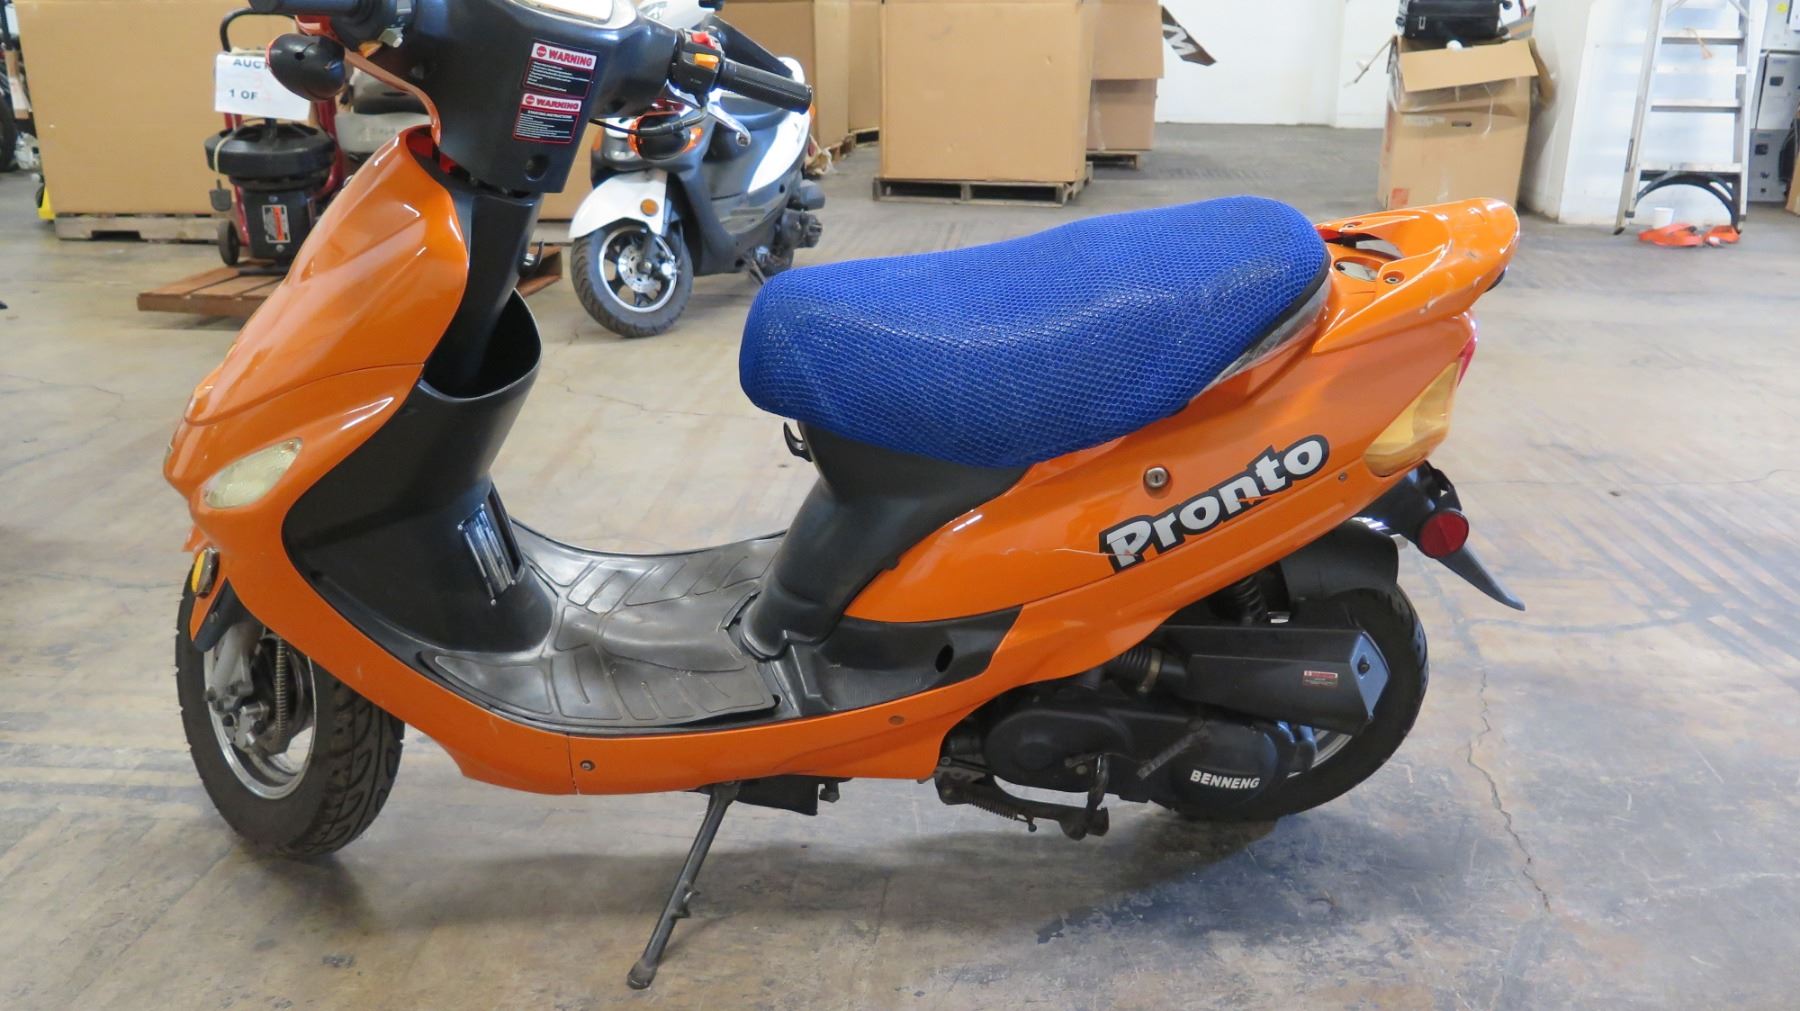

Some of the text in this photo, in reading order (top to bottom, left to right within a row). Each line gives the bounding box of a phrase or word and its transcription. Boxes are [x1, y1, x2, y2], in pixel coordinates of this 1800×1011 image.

[548, 49, 593, 67] WARNING
[229, 88, 258, 100] 1 OF
[536, 98, 579, 110] WARNING
[1104, 438, 1325, 569] Pronto
[1190, 769, 1261, 789] BENNENG
